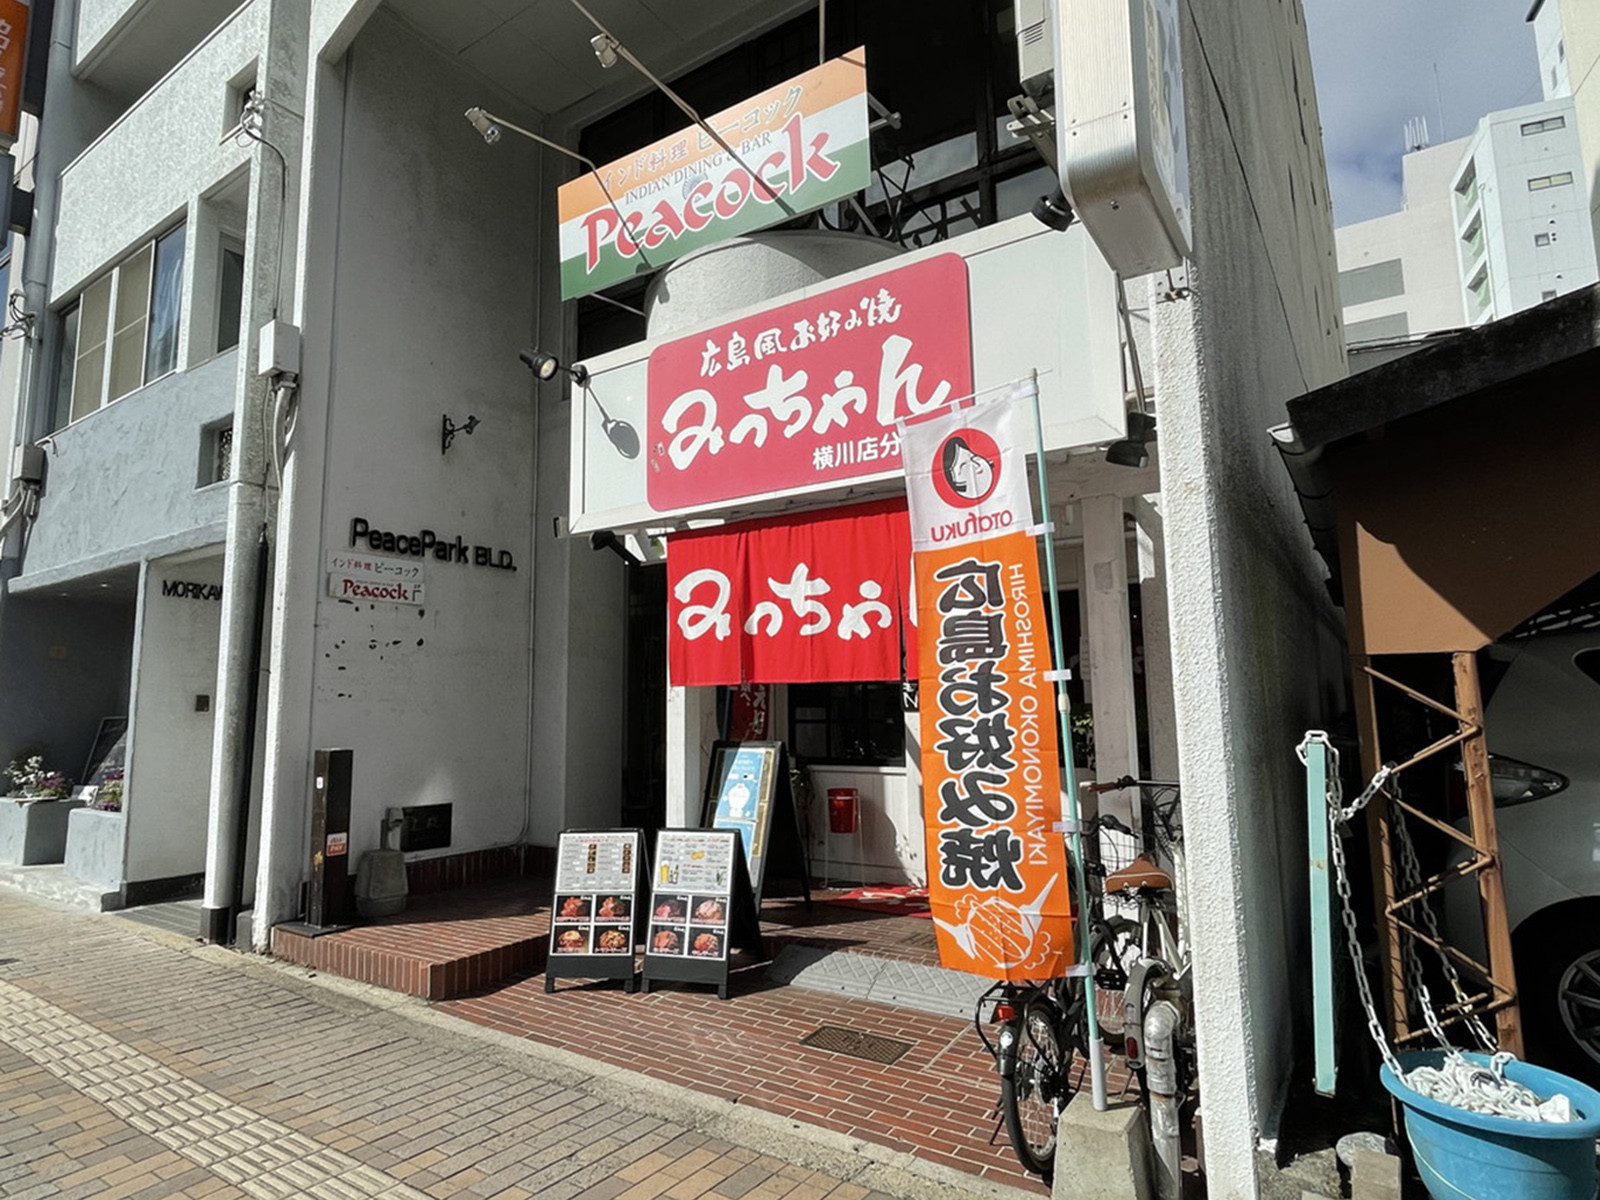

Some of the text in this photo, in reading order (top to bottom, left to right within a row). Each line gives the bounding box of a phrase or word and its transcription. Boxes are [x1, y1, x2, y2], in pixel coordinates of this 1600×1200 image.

[579, 111, 842, 276] Peacock
[600, 138, 689, 192] インド料理
[624, 169, 673, 205] INDIAN
[669, 149, 725, 188] DINING
[741, 131, 773, 157] BAR
[700, 287, 903, 377] 広島風お好み焼
[661, 334, 952, 471] みっちゃん
[331, 556, 372, 572] インド料理
[350, 517, 518, 572] PeacePark BLD.
[342, 578, 409, 601] Peacock
[674, 562, 918, 641] みっちゃ
